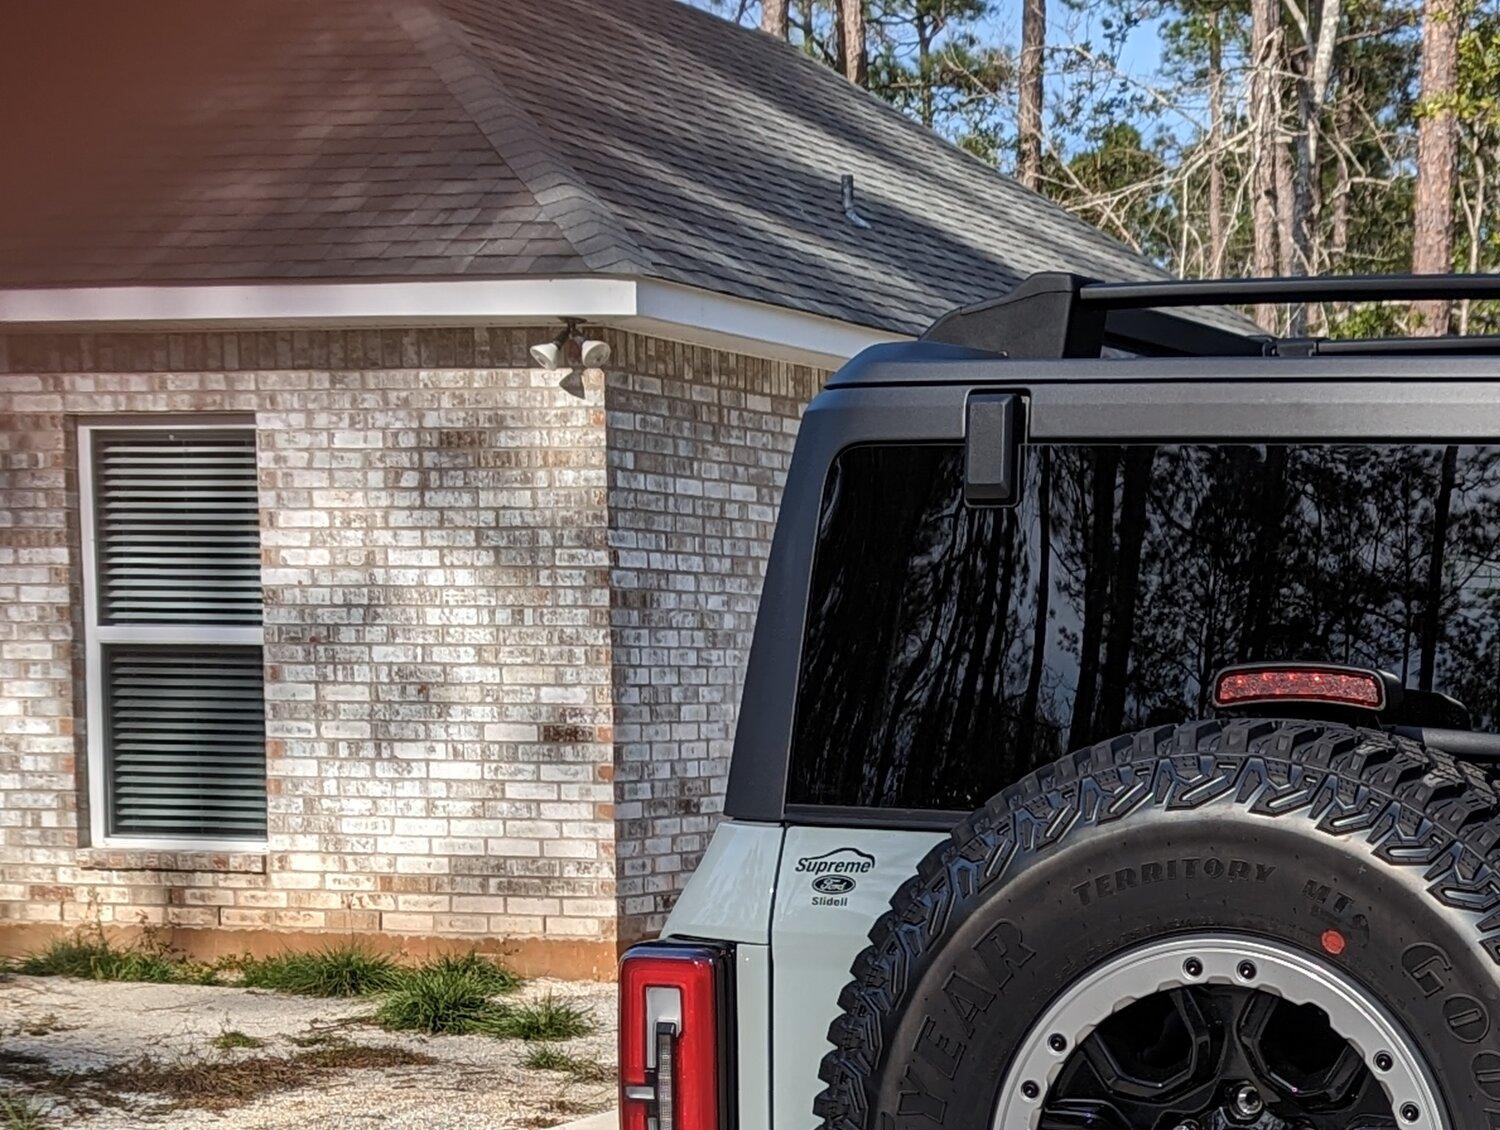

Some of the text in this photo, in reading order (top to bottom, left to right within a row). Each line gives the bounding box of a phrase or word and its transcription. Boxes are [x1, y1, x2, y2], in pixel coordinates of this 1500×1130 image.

[794, 857, 872, 875] Supreme
[1071, 857, 1354, 914] TERRITORY MT
[811, 896, 848, 907] Slidell
